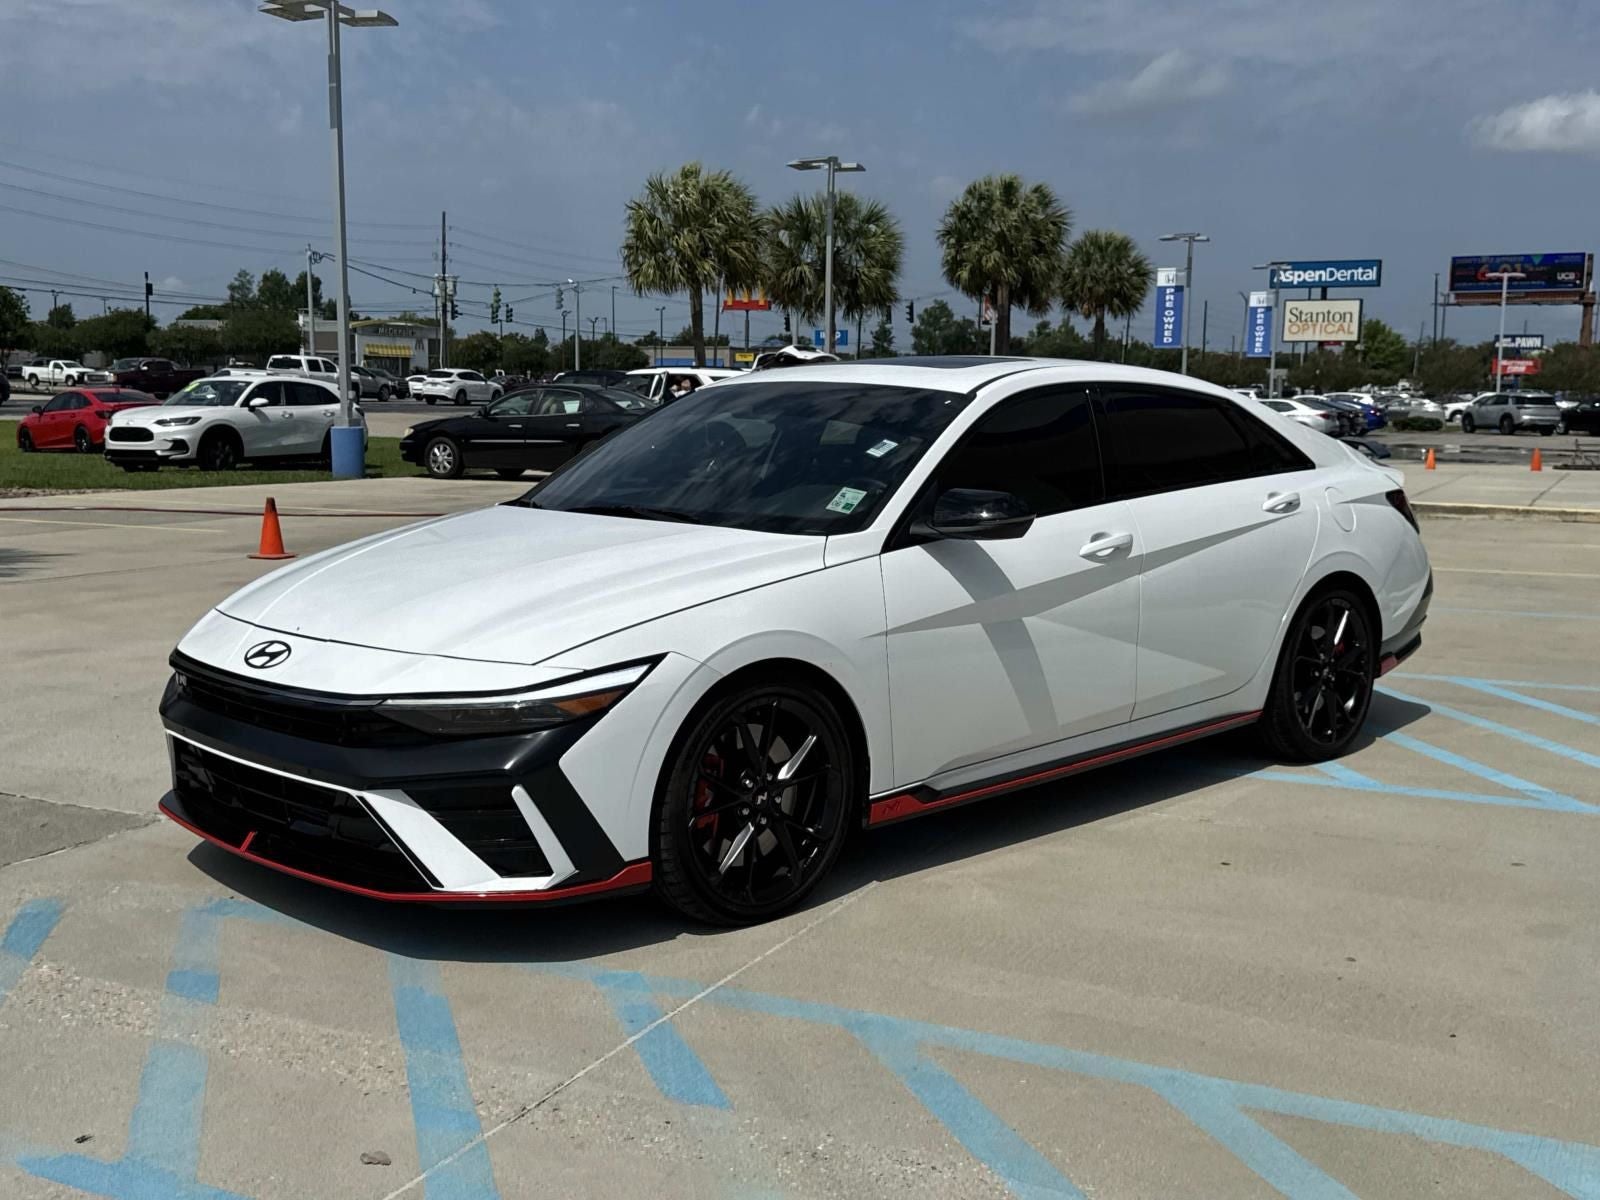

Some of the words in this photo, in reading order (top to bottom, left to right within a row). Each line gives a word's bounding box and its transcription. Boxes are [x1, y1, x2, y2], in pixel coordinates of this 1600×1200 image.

[1165, 287, 1175, 308] PRE
[1288, 307, 1353, 324] Stanton
[1163, 309, 1175, 343] OWNED
[1288, 323, 1354, 335] OPTICAL
[1514, 336, 1542, 348] PAWN
